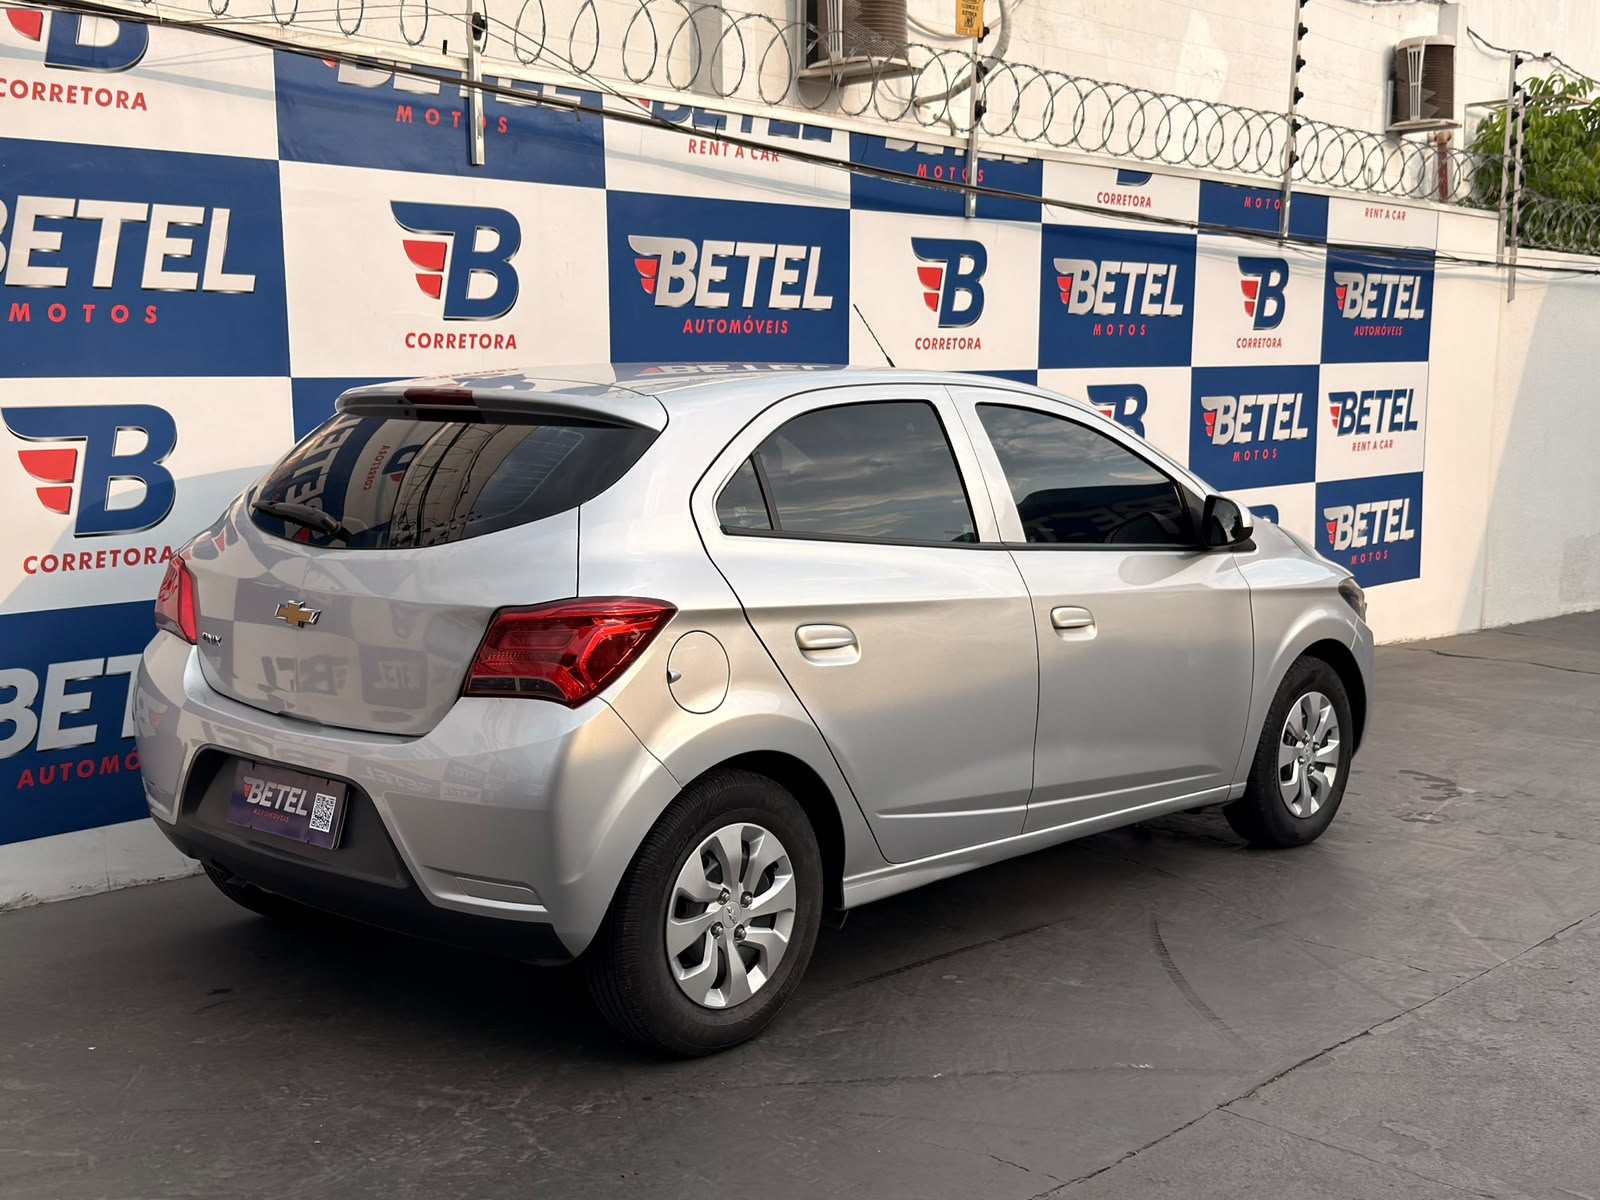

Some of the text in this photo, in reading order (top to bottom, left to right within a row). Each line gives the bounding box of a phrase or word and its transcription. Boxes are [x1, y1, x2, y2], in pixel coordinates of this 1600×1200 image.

[688, 138, 730, 158] RENT
[734, 145, 745, 159] A
[1096, 191, 1153, 209] CORRETORA
[1243, 196, 1282, 211] MOTO
[1365, 207, 1406, 221] RENT A CAR
[0, 195, 256, 293] ETEL
[628, 235, 834, 311] BETEL
[1053, 257, 1184, 317] BETEL
[1333, 271, 1425, 320] BETEL
[8, 303, 158, 325] MOTOS
[682, 316, 789, 335] AUTOMÓVEIS
[1093, 324, 1147, 336] MOTOS
[1353, 324, 1403, 337] AUTOMÓVEIS
[404, 331, 518, 350] CORRETORA
[914, 337, 982, 351] CORRETORA
[1235, 337, 1283, 349] CORRETORA
[1201, 393, 1308, 446] BETEL
[1328, 388, 1419, 437] BETEL
[1352, 438, 1394, 452] RENT A CAR
[1232, 448, 1278, 463] MOTOS
[1323, 497, 1415, 551] BETEL
[23, 546, 173, 575] CORRETORA
[1350, 550, 1389, 566] MOTOS
[16, 746, 141, 790] AUTOMÓ
[243, 776, 308, 817] BETEL
